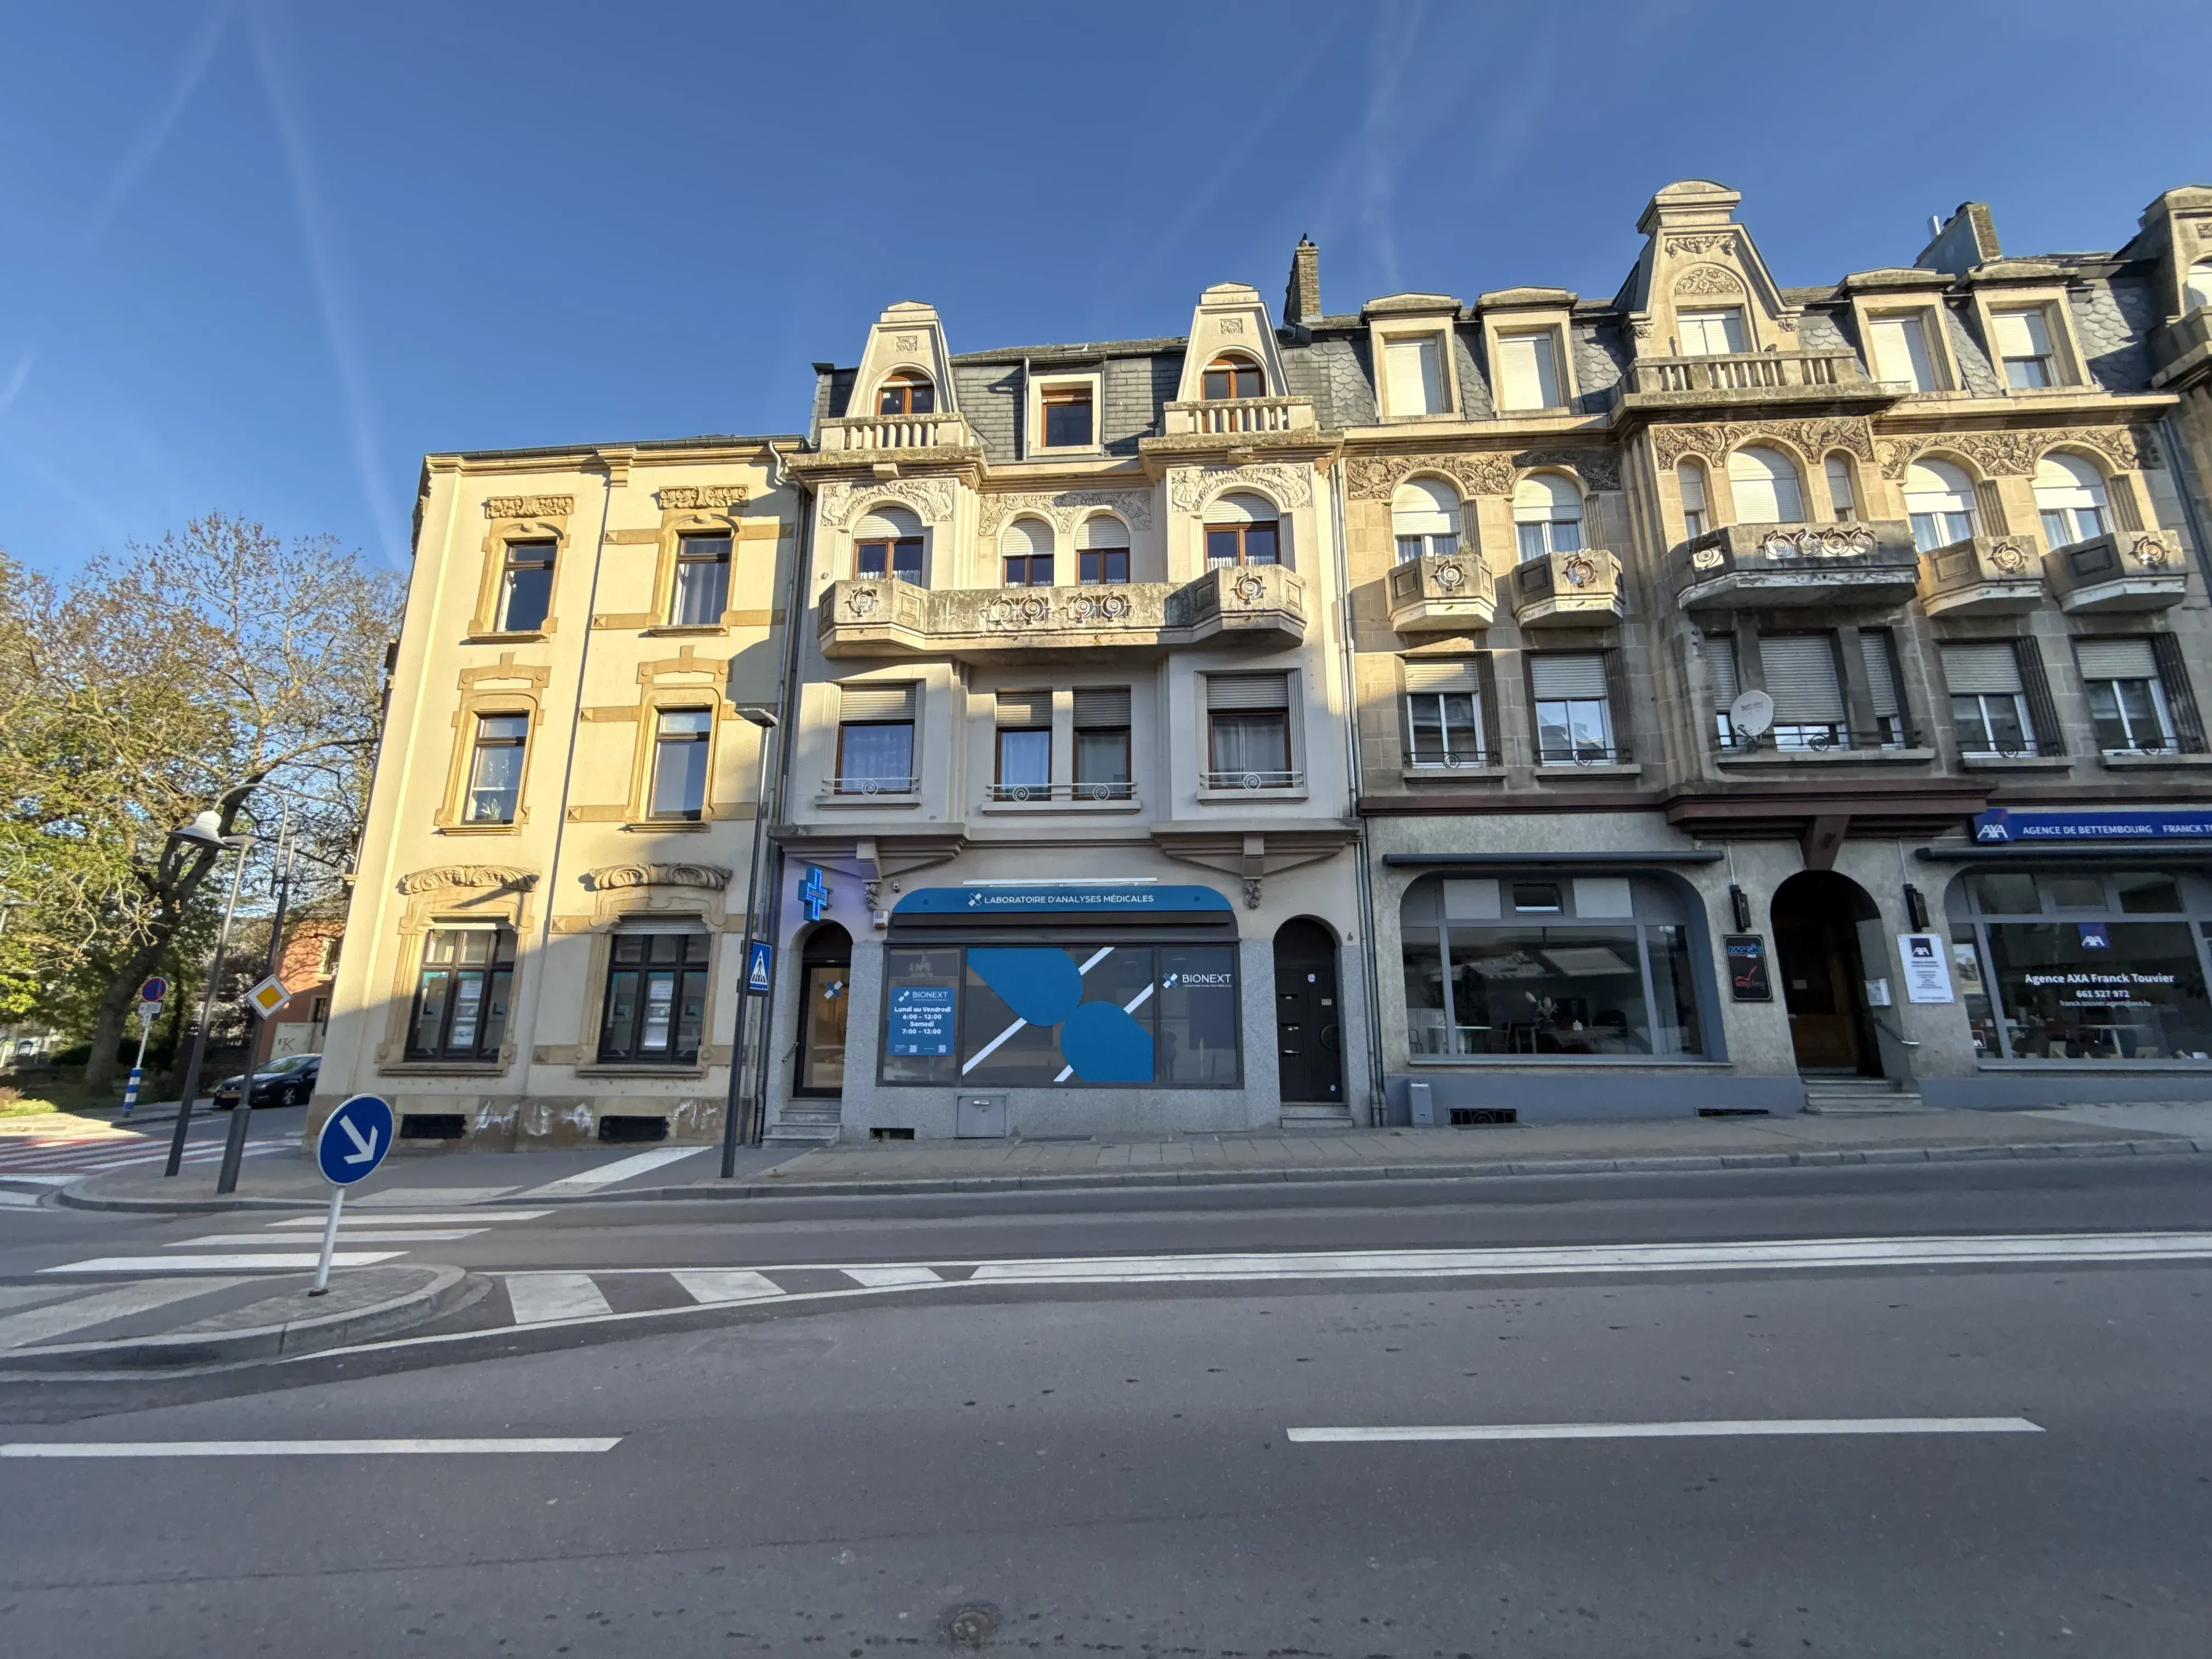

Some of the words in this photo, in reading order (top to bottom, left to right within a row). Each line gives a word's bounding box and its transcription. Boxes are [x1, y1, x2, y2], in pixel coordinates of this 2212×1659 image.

[1977, 824, 2008, 838] AXA
[2023, 826, 2061, 834] AGENCE
[2063, 826, 2076, 834] DE
[2078, 825, 2153, 834] BETTEMBOURG
[2163, 825, 2203, 833] FRANCK
[1048, 895, 1102, 903] D'ANALYSES
[1104, 894, 1154, 902] MÉDICALES
[1347, 932, 1353, 941] 6
[2081, 935, 2105, 946] AXA
[1912, 947, 1930, 955] AXA
[1182, 974, 1232, 983] BIONEXT
[2025, 974, 2065, 986] Agence
[2067, 973, 2090, 983] AXA
[2090, 973, 2130, 983] Franck
[2131, 972, 2175, 983] Touvier
[2094, 990, 2111, 998] 527
